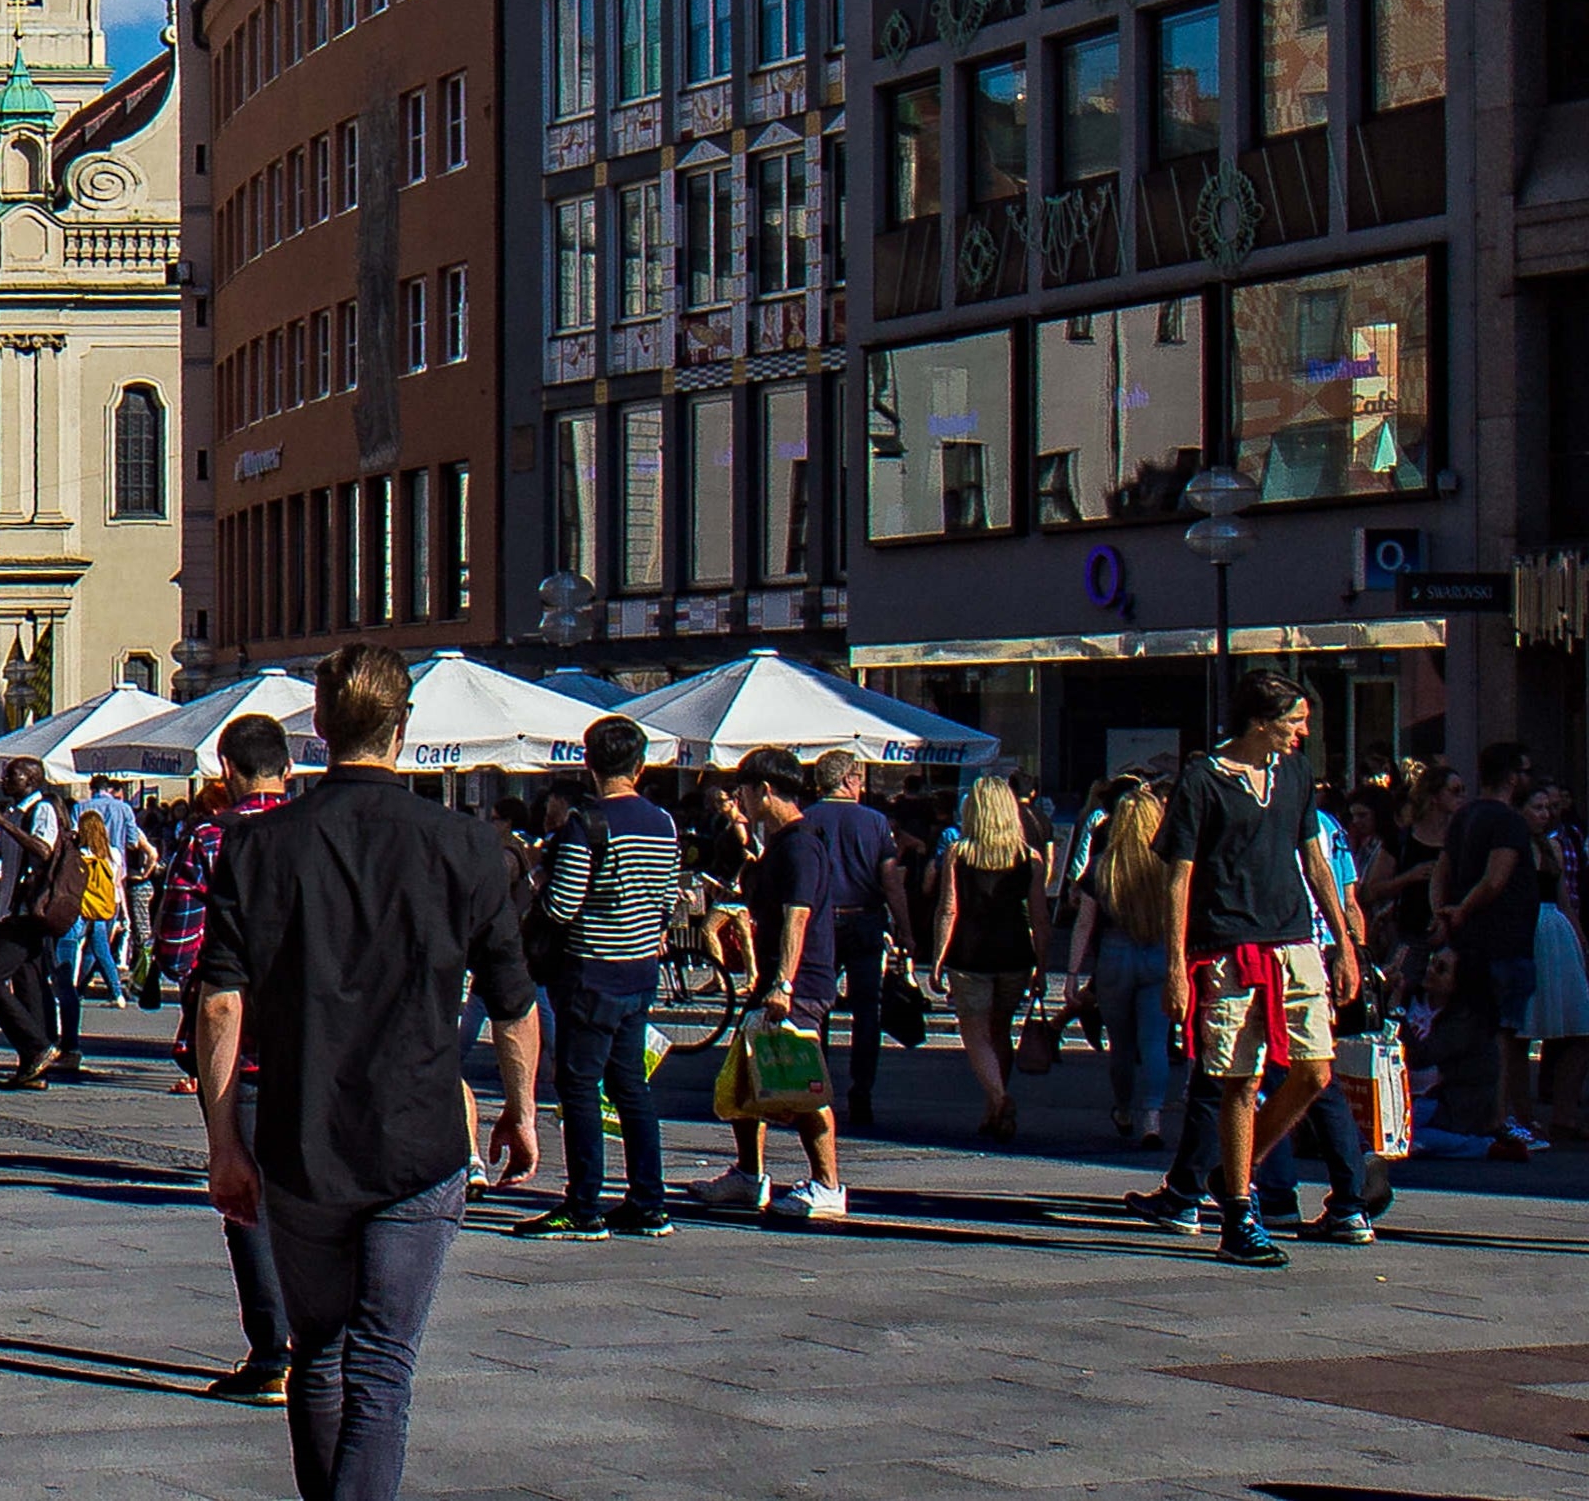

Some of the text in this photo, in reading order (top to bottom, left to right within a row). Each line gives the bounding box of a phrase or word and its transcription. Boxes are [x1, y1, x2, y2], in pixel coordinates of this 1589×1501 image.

[1425, 585, 1493, 599] SWAROVSKI
[415, 743, 462, 764] Café
[883, 740, 968, 762] Rischart
